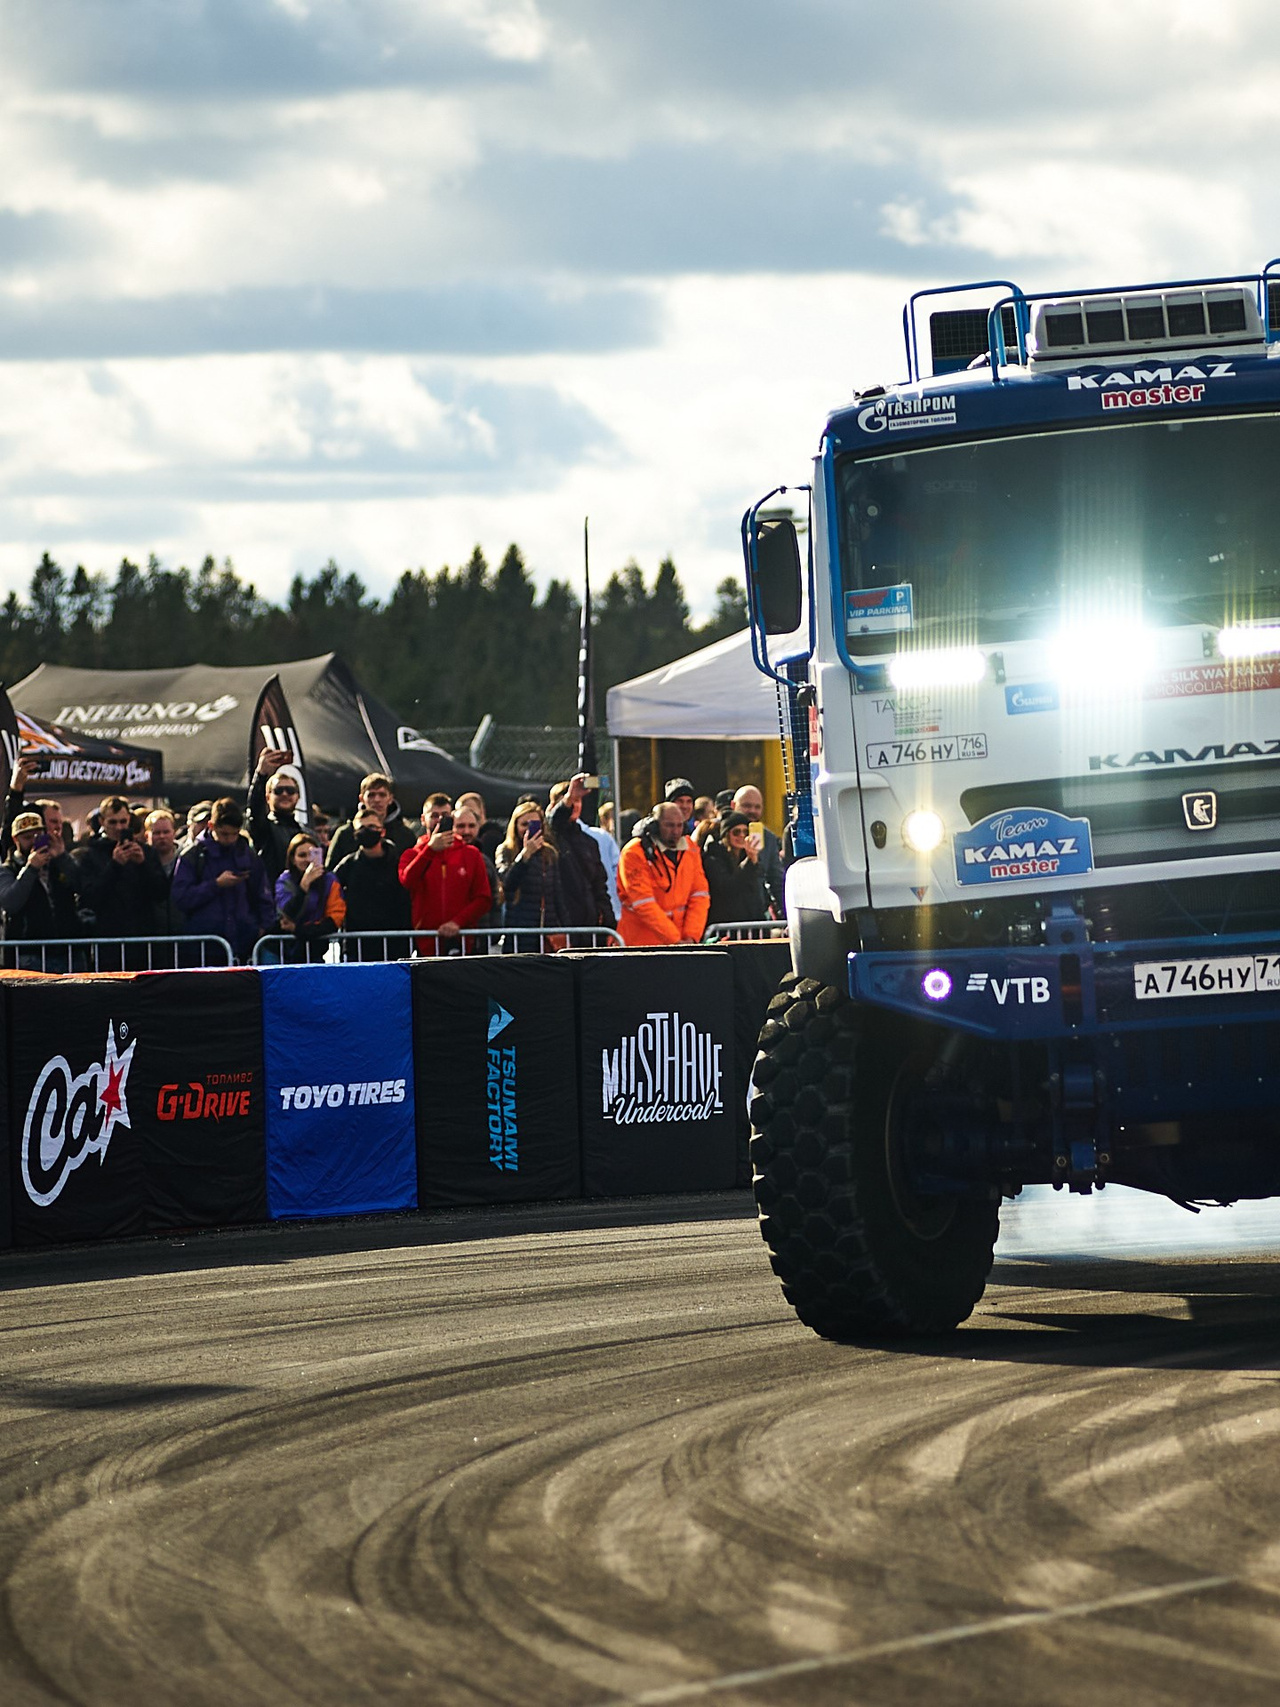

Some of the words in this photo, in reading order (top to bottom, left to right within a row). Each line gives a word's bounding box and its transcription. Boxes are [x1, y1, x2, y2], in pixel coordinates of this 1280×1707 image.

[1067, 363, 1236, 390] KAMAZ
[887, 395, 956, 416] ГАЗПРОМ
[1101, 384, 1205, 409] master
[896, 591, 904, 602] P
[849, 609, 865, 617] VIP
[867, 605, 908, 616] PARKING
[1171, 670, 1199, 683] SILK
[1201, 667, 1231, 680] WAY
[1236, 663, 1276, 677] RALLY
[53, 702, 199, 725] INFERNO
[962, 737, 981, 750] 716
[962, 749, 976, 757] RUS
[990, 815, 1048, 841] Team
[964, 838, 1079, 864] KAMAZ
[990, 859, 1059, 878] master
[990, 976, 1051, 1004] VTB
[280, 1084, 343, 1110] TOYO
[347, 1079, 406, 1107] TIRES
[487, 1048, 503, 1171] FACTORY
[503, 1046, 518, 1171] TSUNAMI
[615, 1091, 714, 1125] Undercoal
